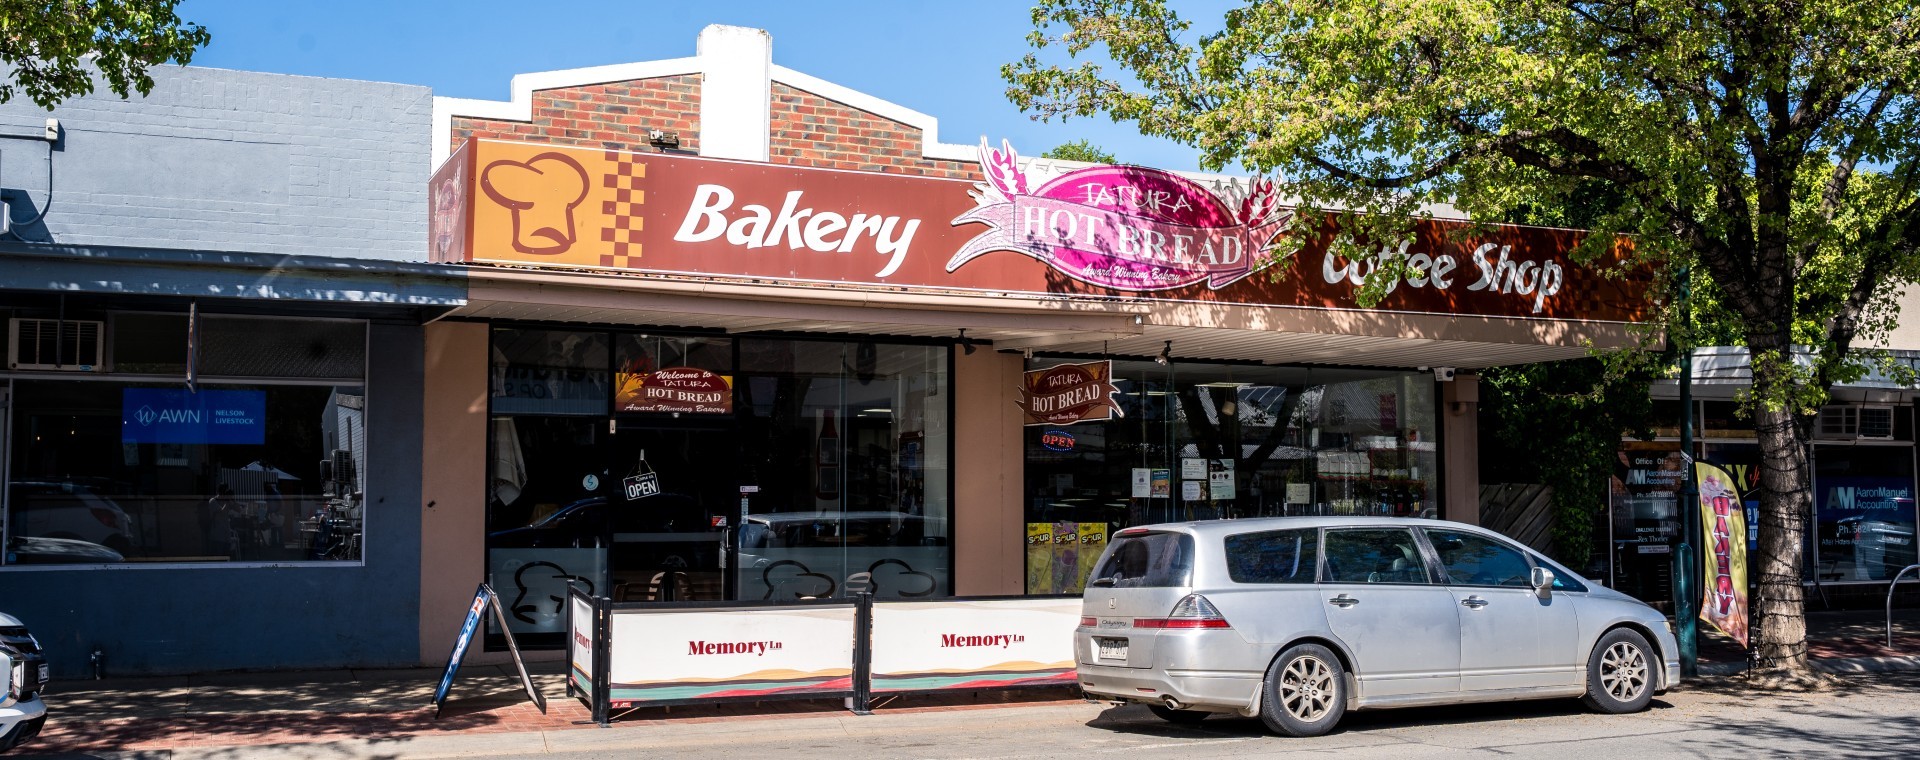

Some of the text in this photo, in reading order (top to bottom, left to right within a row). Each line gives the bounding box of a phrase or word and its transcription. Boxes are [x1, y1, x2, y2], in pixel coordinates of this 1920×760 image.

[1077, 182, 1193, 213] TATURA
[673, 184, 922, 278] Bakery
[1023, 205, 1243, 266] HOT BREAD
[1081, 263, 1182, 283] Award Winning Bakery
[1467, 242, 1563, 314] Shop
[655, 371, 699, 379] Welcome
[1047, 373, 1083, 387] TATURA
[660, 380, 711, 388] TATURA
[647, 388, 721, 403] HOT BREAD
[1032, 384, 1100, 412] HOT BREAD
[215, 409, 245, 417] NELSON
[624, 403, 726, 414] Award Winning Bakery
[158, 409, 200, 424] AWN
[215, 417, 255, 425] LIVESTOCK
[1042, 434, 1076, 448] OPEN
[1635, 457, 1653, 465] Office
[1625, 468, 1646, 485] AM
[1646, 478, 1676, 486] Accounting
[628, 479, 657, 498] OPEN
[1856, 486, 1908, 498] AaronManuel
[1826, 486, 1855, 510] AM
[1856, 500, 1898, 511] Accounting
[1838, 525, 1851, 534] Ph.
[1711, 495, 1734, 616] BAKERY
[1101, 619, 1127, 627] Odyssey
[688, 639, 782, 656] Memory Ln
[940, 633, 1025, 649] Memory Ln
